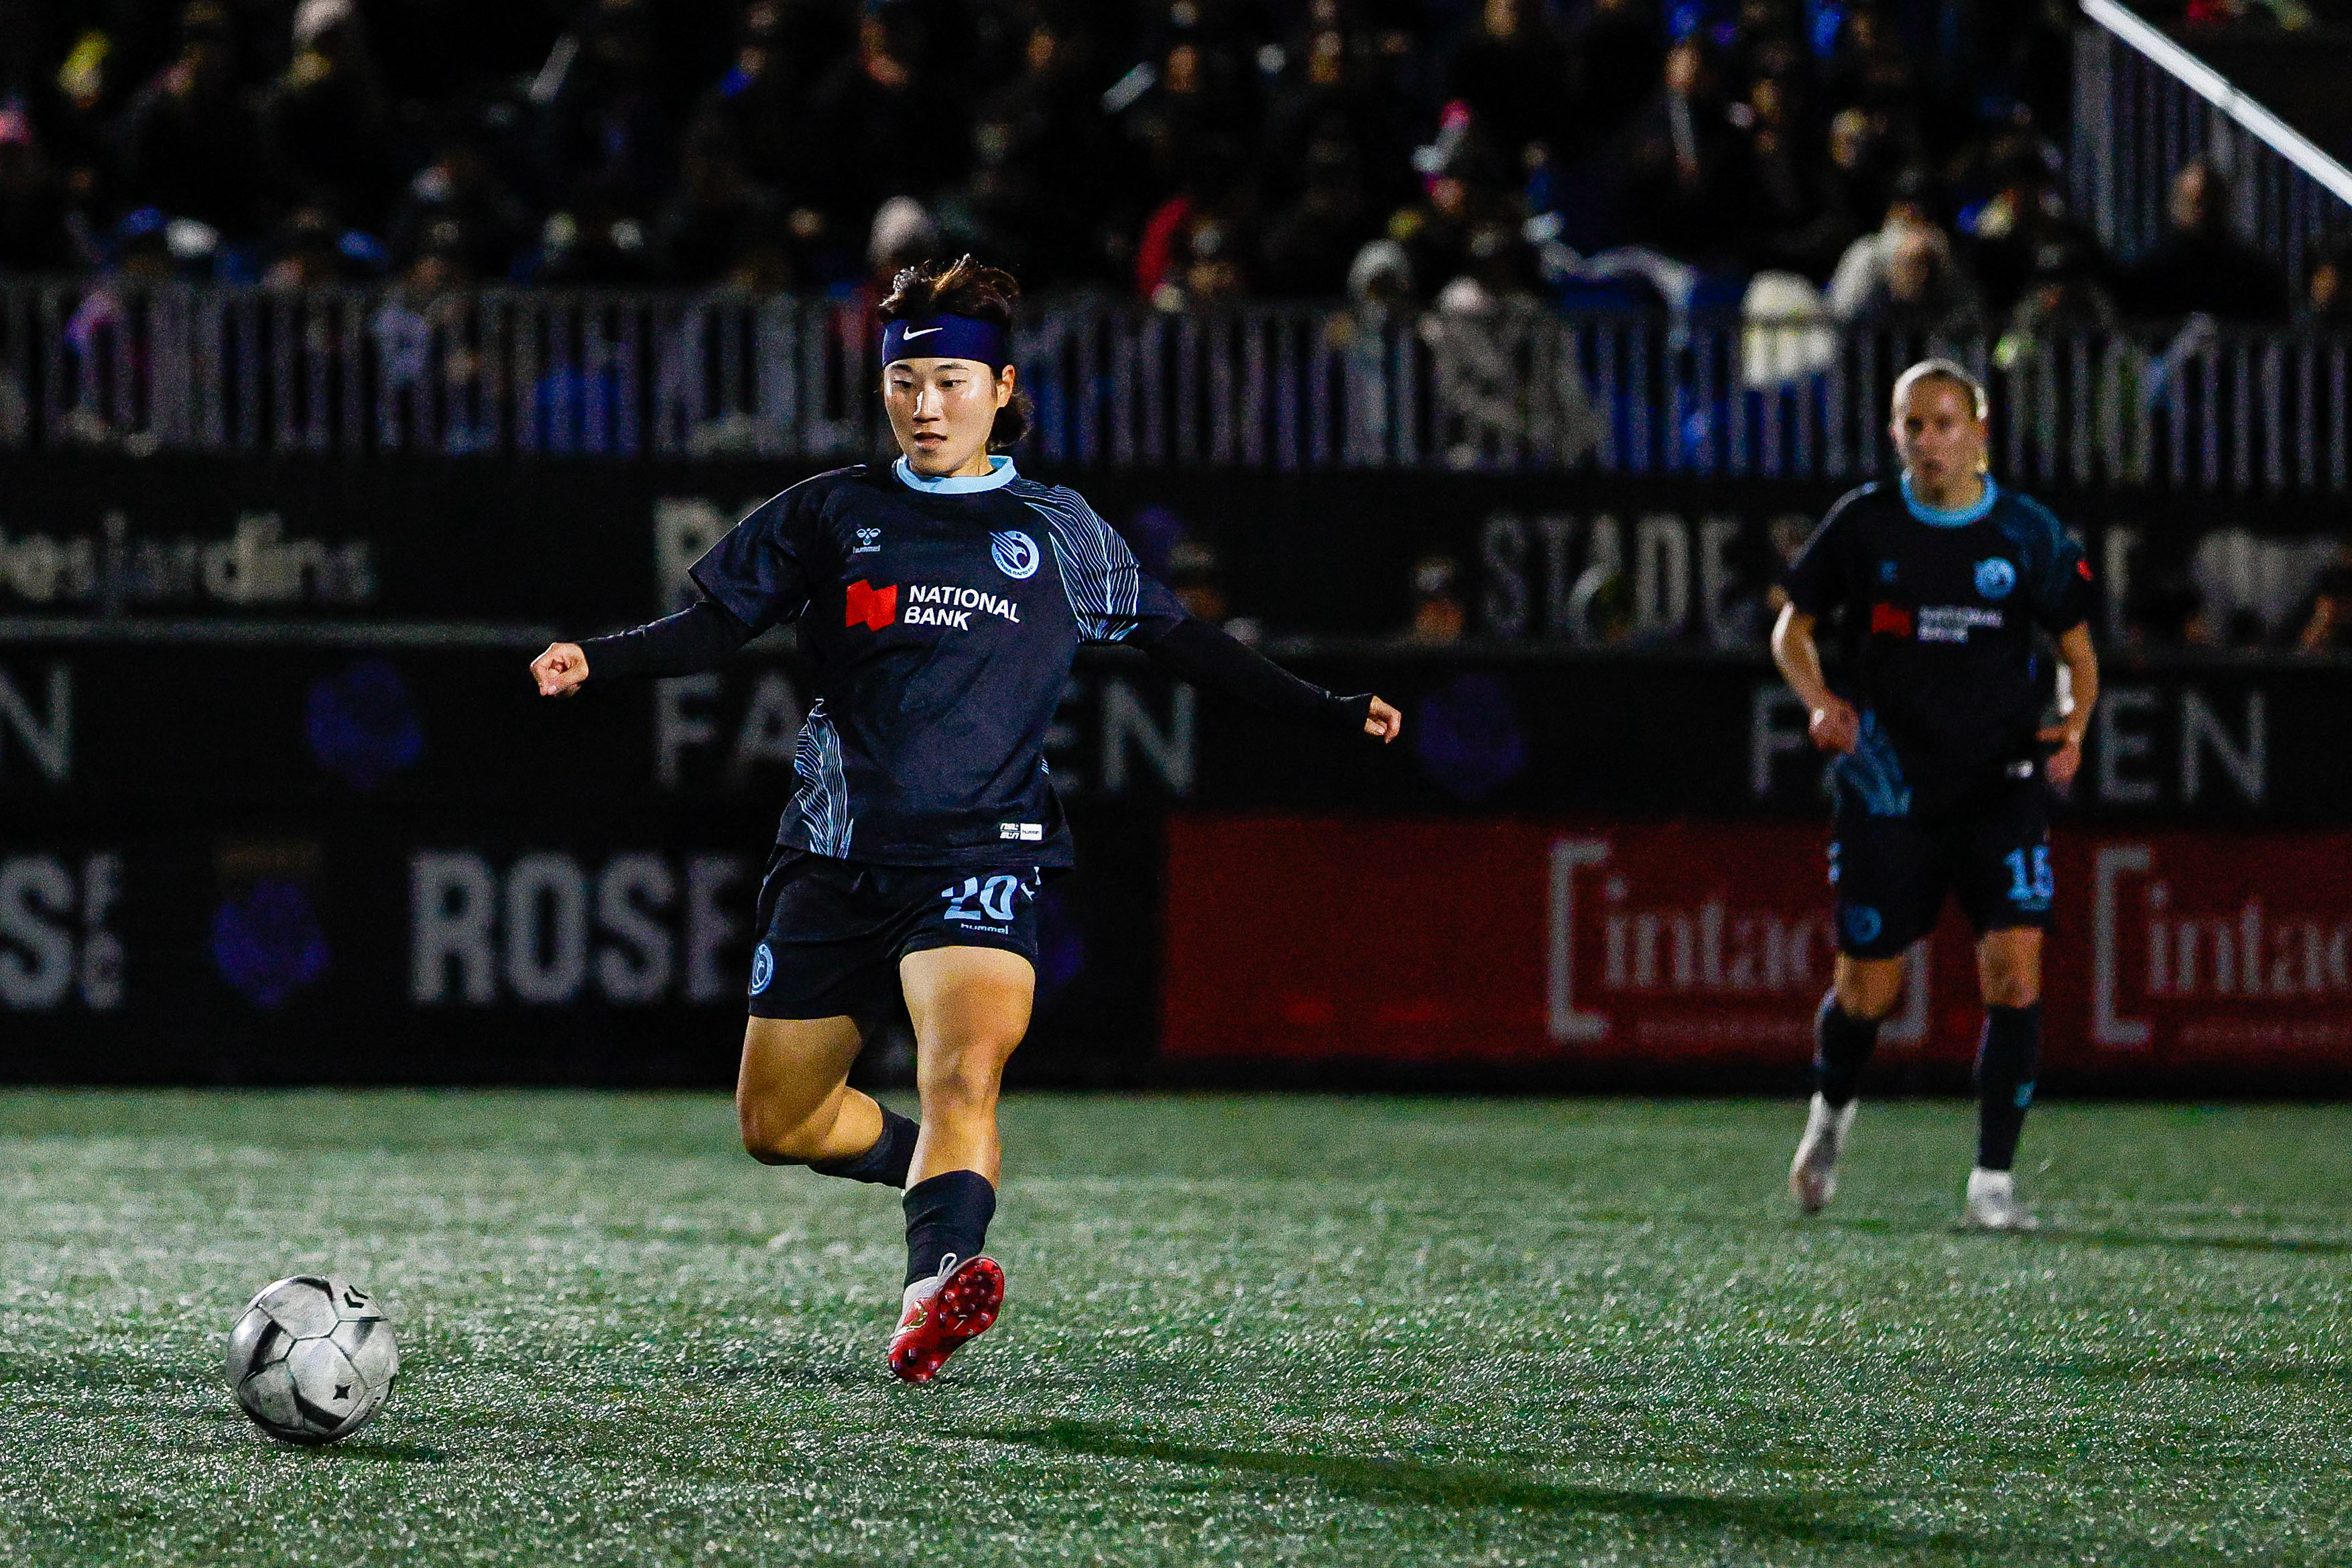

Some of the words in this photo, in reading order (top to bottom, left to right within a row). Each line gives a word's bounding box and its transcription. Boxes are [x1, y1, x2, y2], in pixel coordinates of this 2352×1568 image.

[0, 509, 377, 616] esjardins
[904, 606, 972, 631] BANK
[909, 585, 1020, 623] NATIONAL
[941, 875, 1017, 920] 20
[410, 850, 752, 1005] ROSE
[960, 923, 1009, 935] hummel
[1603, 874, 1837, 993] intac
